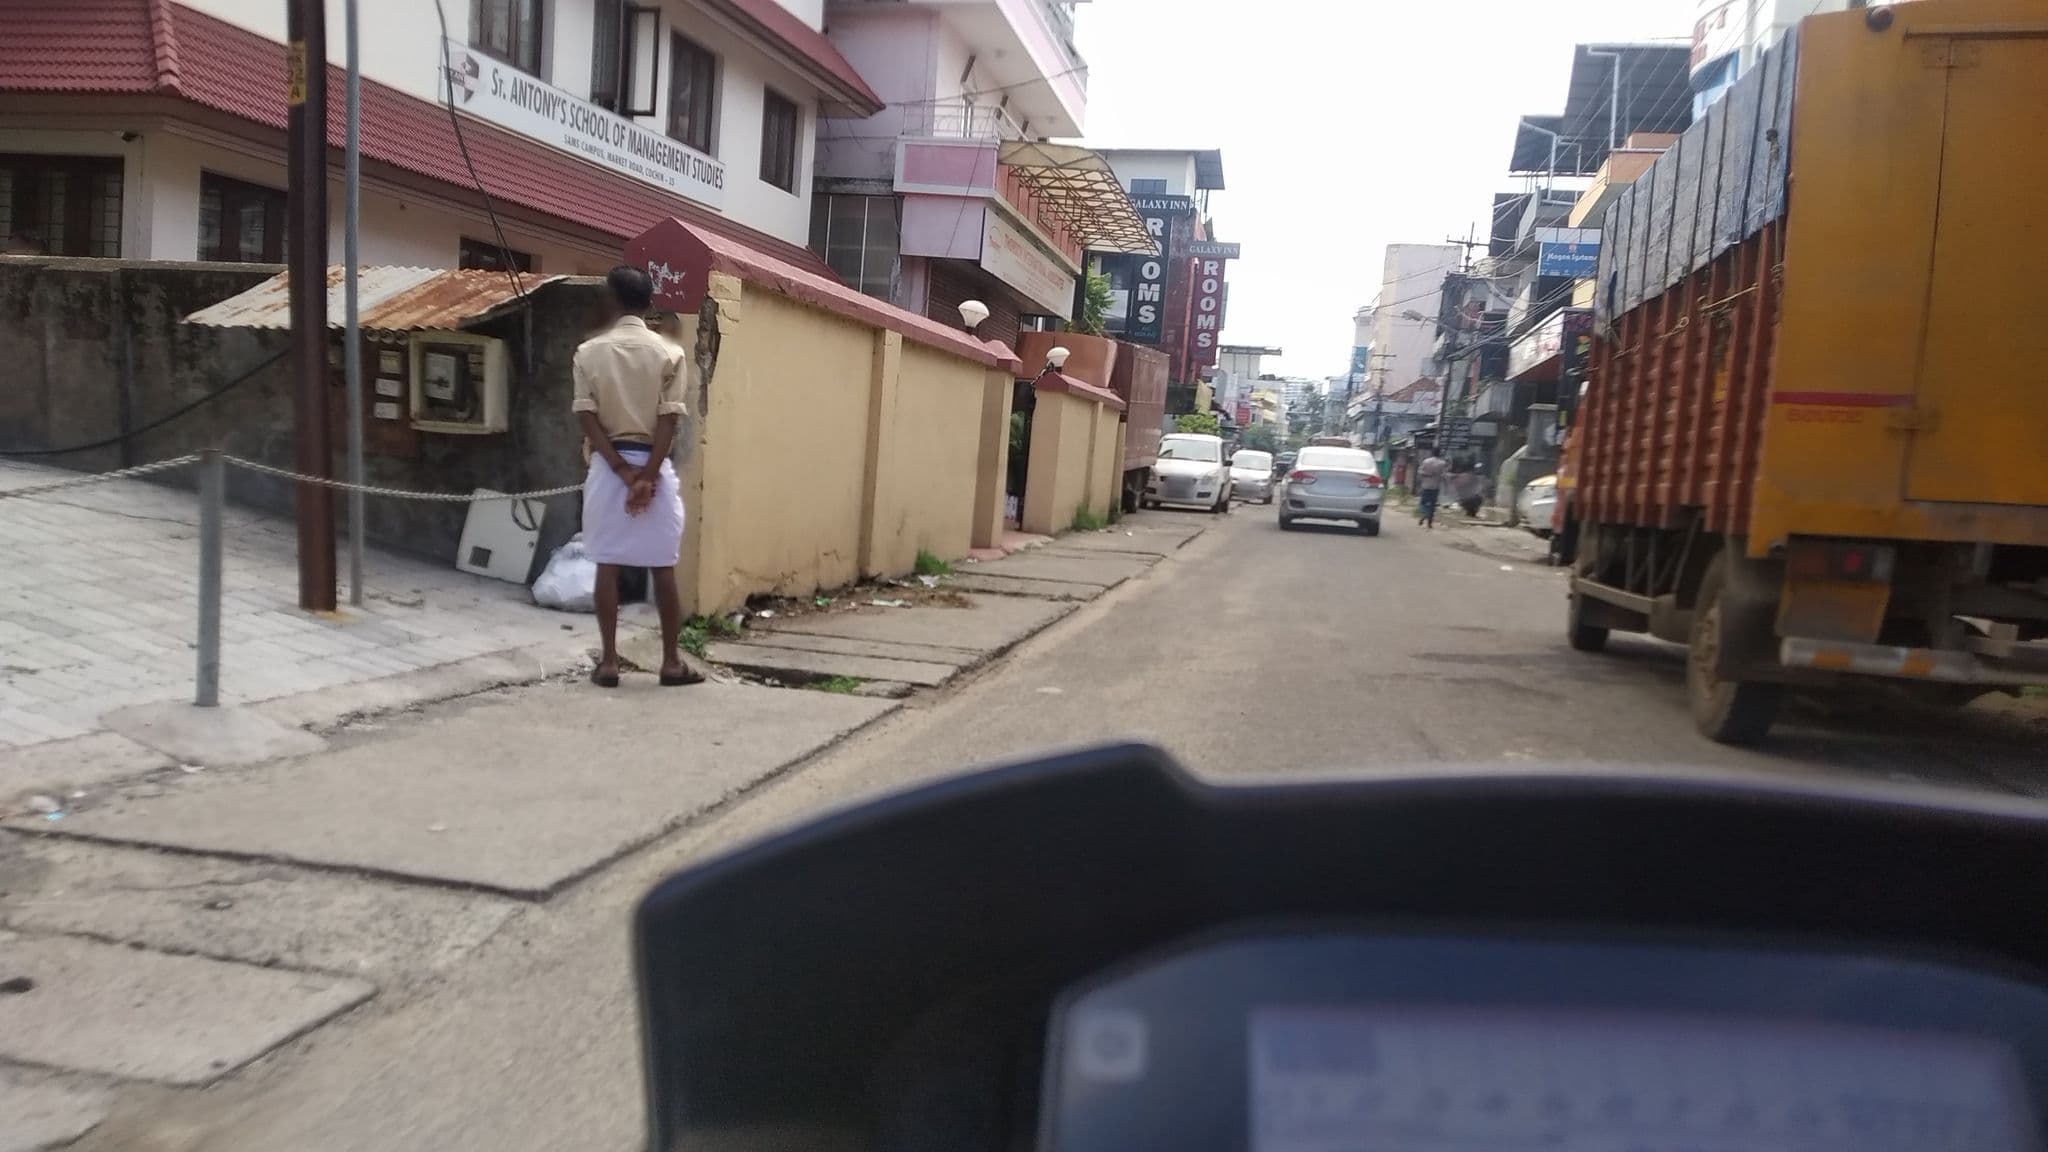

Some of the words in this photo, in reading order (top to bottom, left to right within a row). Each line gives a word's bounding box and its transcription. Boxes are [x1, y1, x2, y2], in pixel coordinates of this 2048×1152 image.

[510, 76, 567, 125] ANTONY'S
[568, 102, 610, 146] SCHOOL
[612, 122, 626, 147] OF
[627, 130, 692, 180] MANAGEMENT
[692, 157, 724, 190] STUDIES
[607, 152, 628, 168] MARKET
[645, 165, 665, 183] COCHIN
[1130, 198, 1169, 210] GALAXY
[1170, 199, 1188, 211] INN
[1189, 245, 1223, 255] GALAXY
[1223, 246, 1239, 256] INN
[1196, 260, 1219, 348] ROOMS
